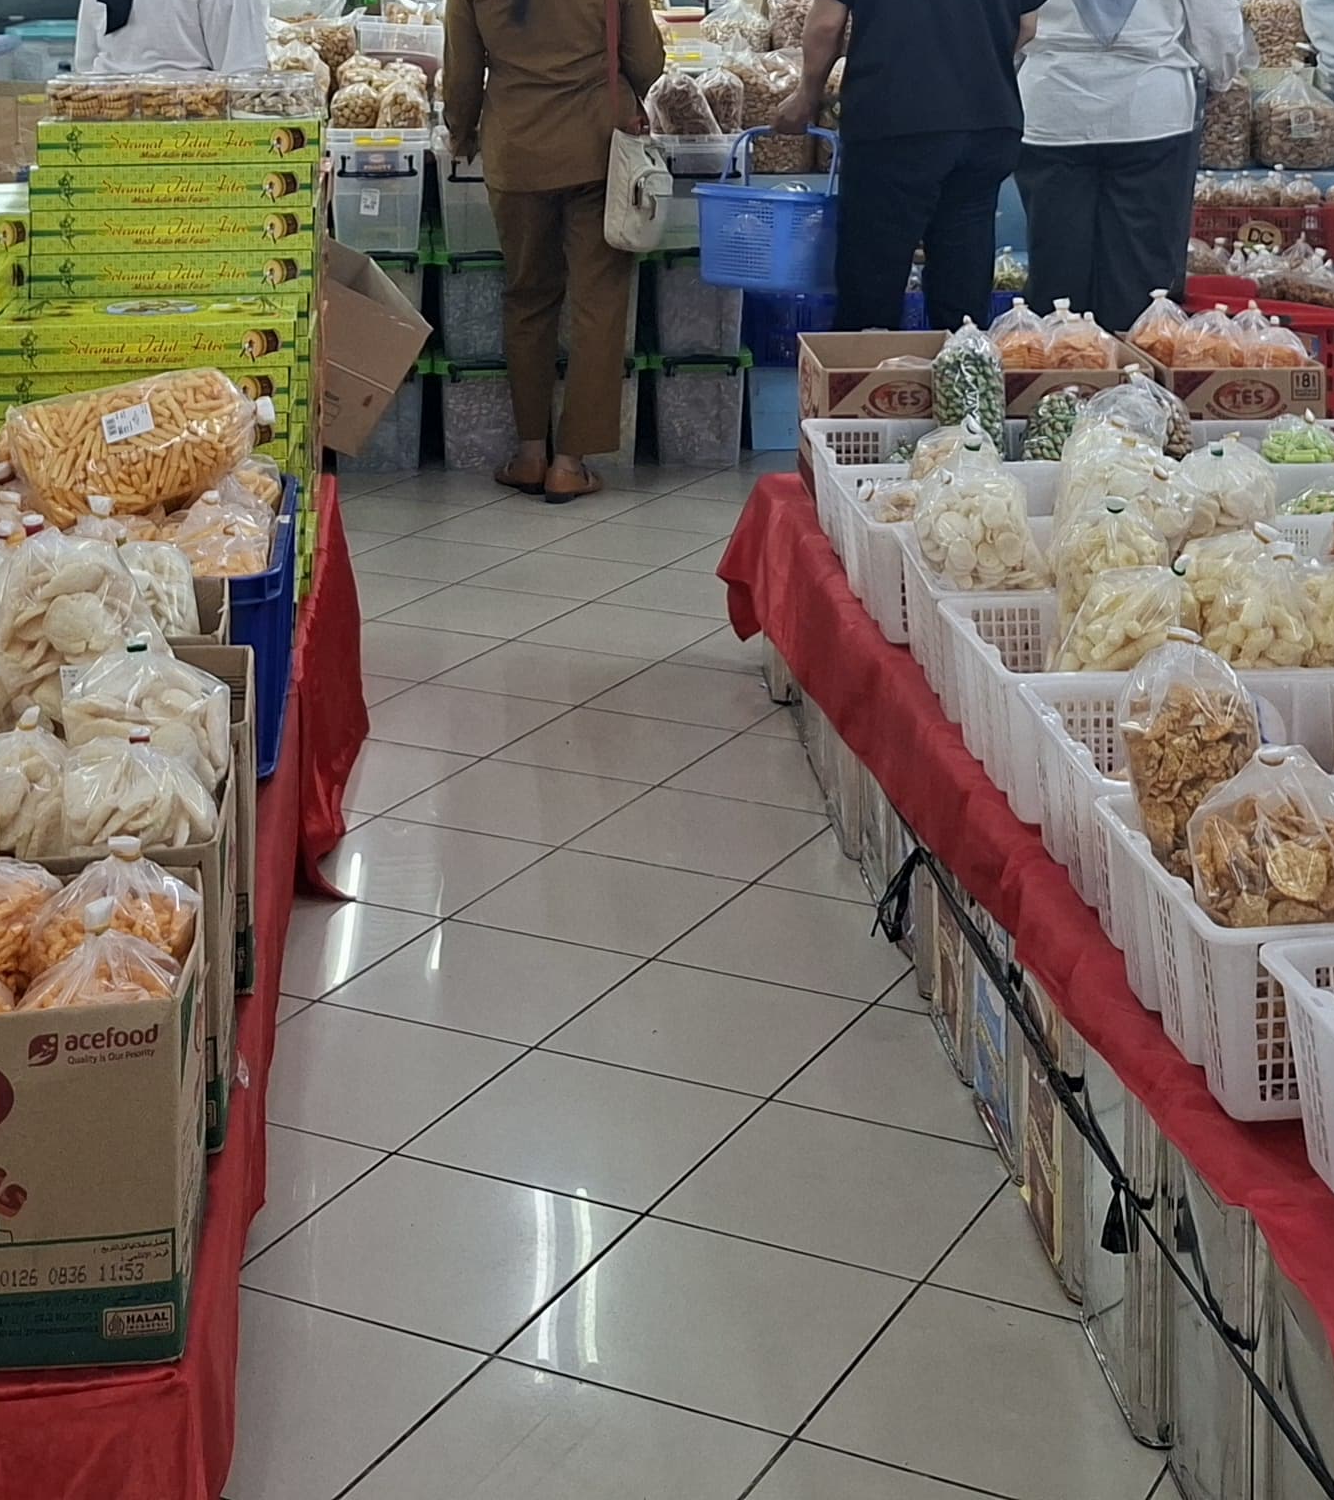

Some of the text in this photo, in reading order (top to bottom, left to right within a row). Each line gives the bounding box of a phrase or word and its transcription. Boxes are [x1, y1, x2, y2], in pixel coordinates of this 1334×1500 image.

[1248, 227, 1274, 246] DC
[1301, 373, 1311, 387] 8
[885, 390, 922, 406] TES
[1229, 389, 1264, 405] TES
[64, 1024, 159, 1052] acefood
[99, 1262, 145, 1283] 11:53
[126, 1311, 168, 1325] HALAL
